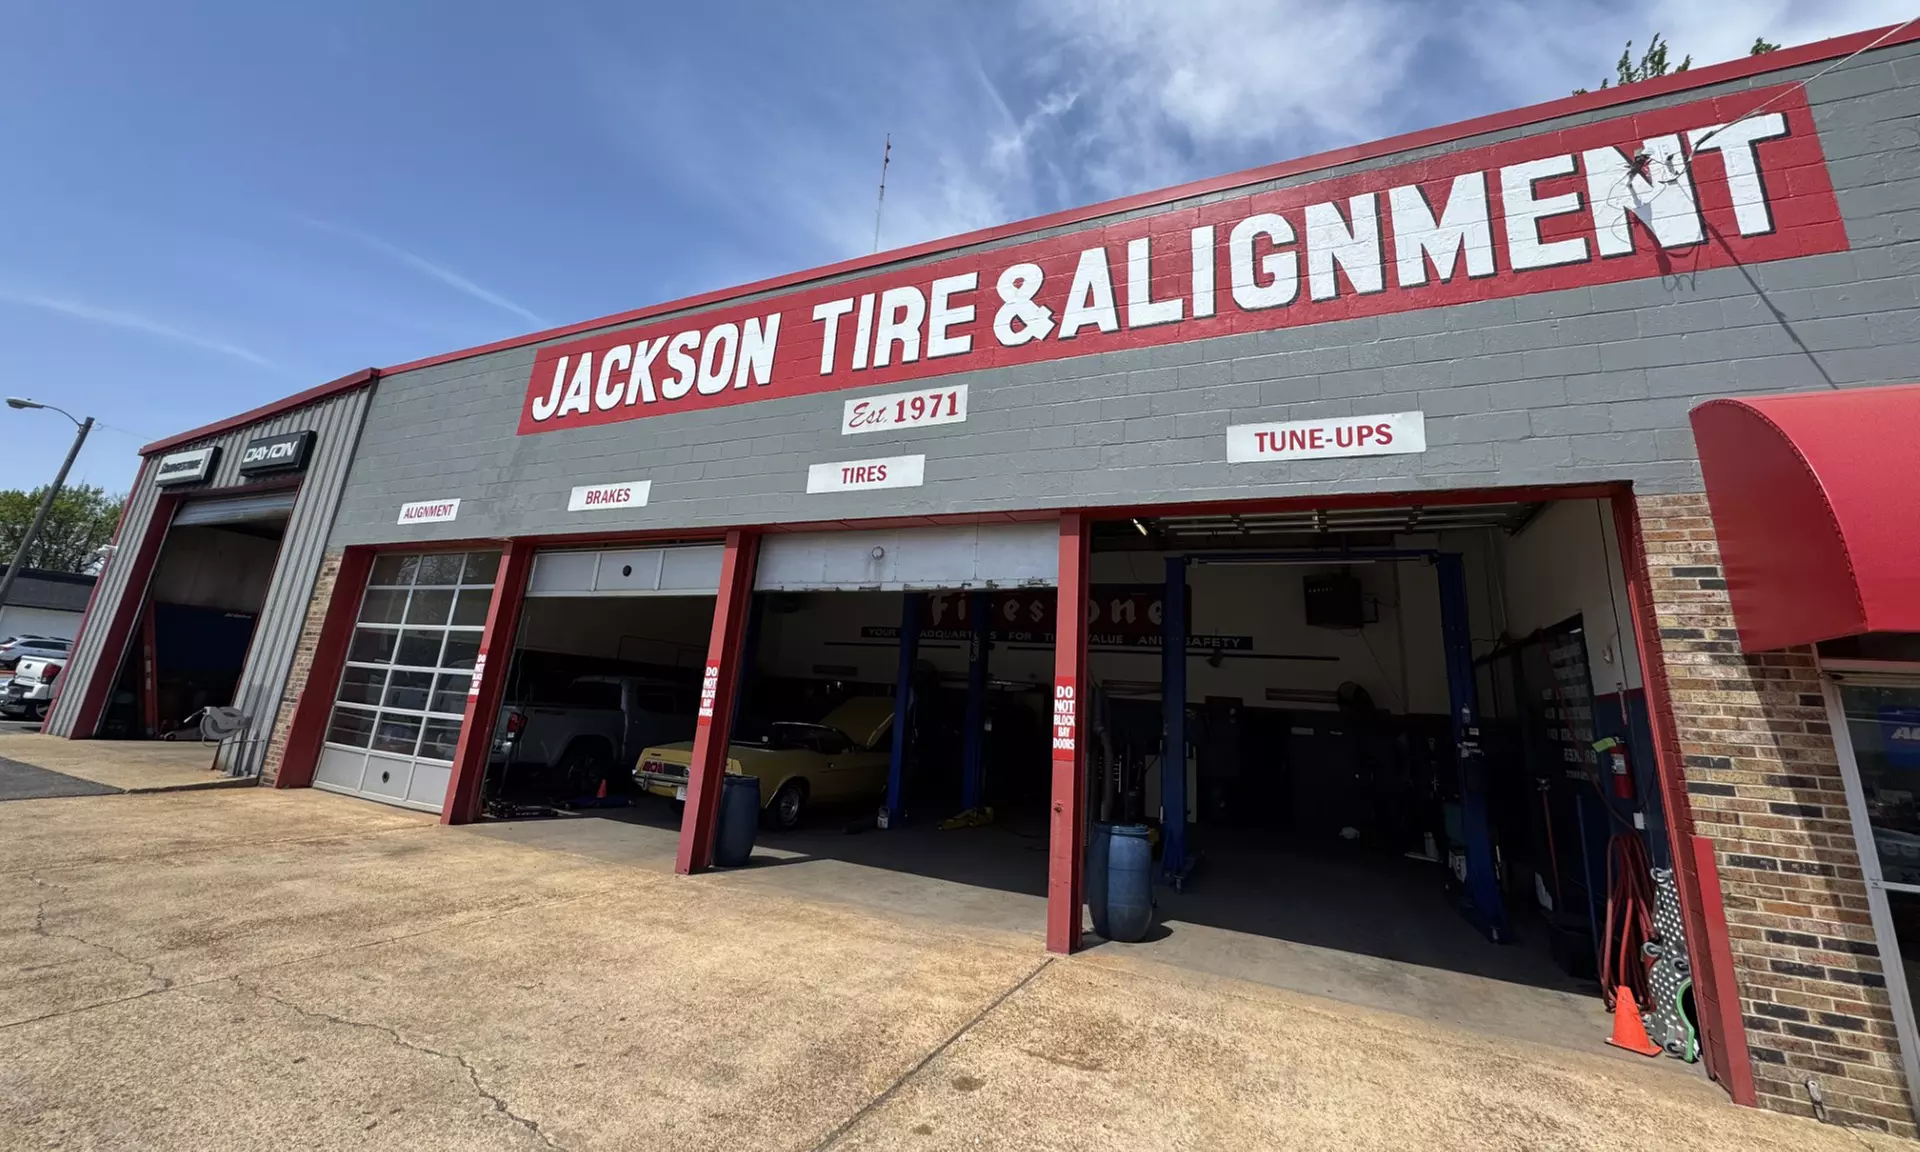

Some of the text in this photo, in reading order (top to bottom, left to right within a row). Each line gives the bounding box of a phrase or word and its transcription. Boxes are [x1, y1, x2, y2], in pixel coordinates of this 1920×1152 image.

[531, 112, 1790, 423] JACKSON TIRE & ALIGNMENT
[848, 391, 959, 428] Est. 1971
[1254, 423, 1393, 453] TUNE-UPS
[242, 441, 298, 464] DAYTON
[842, 464, 887, 484] TIRES
[585, 488, 631, 505] BRAKES
[403, 504, 454, 520] ALIGNMENT
[928, 590, 1164, 627] Fiesone
[919, 629, 997, 641] ADQUARTS
[1008, 632, 1033, 641] FOR
[705, 666, 718, 676] DO
[703, 677, 718, 689] NOT
[1056, 686, 1074, 698] DO
[1054, 699, 1076, 713] NOT
[1053, 714, 1076, 726] BLOCK
[1057, 726, 1071, 737] BAY
[1053, 737, 1075, 750] DOORS
